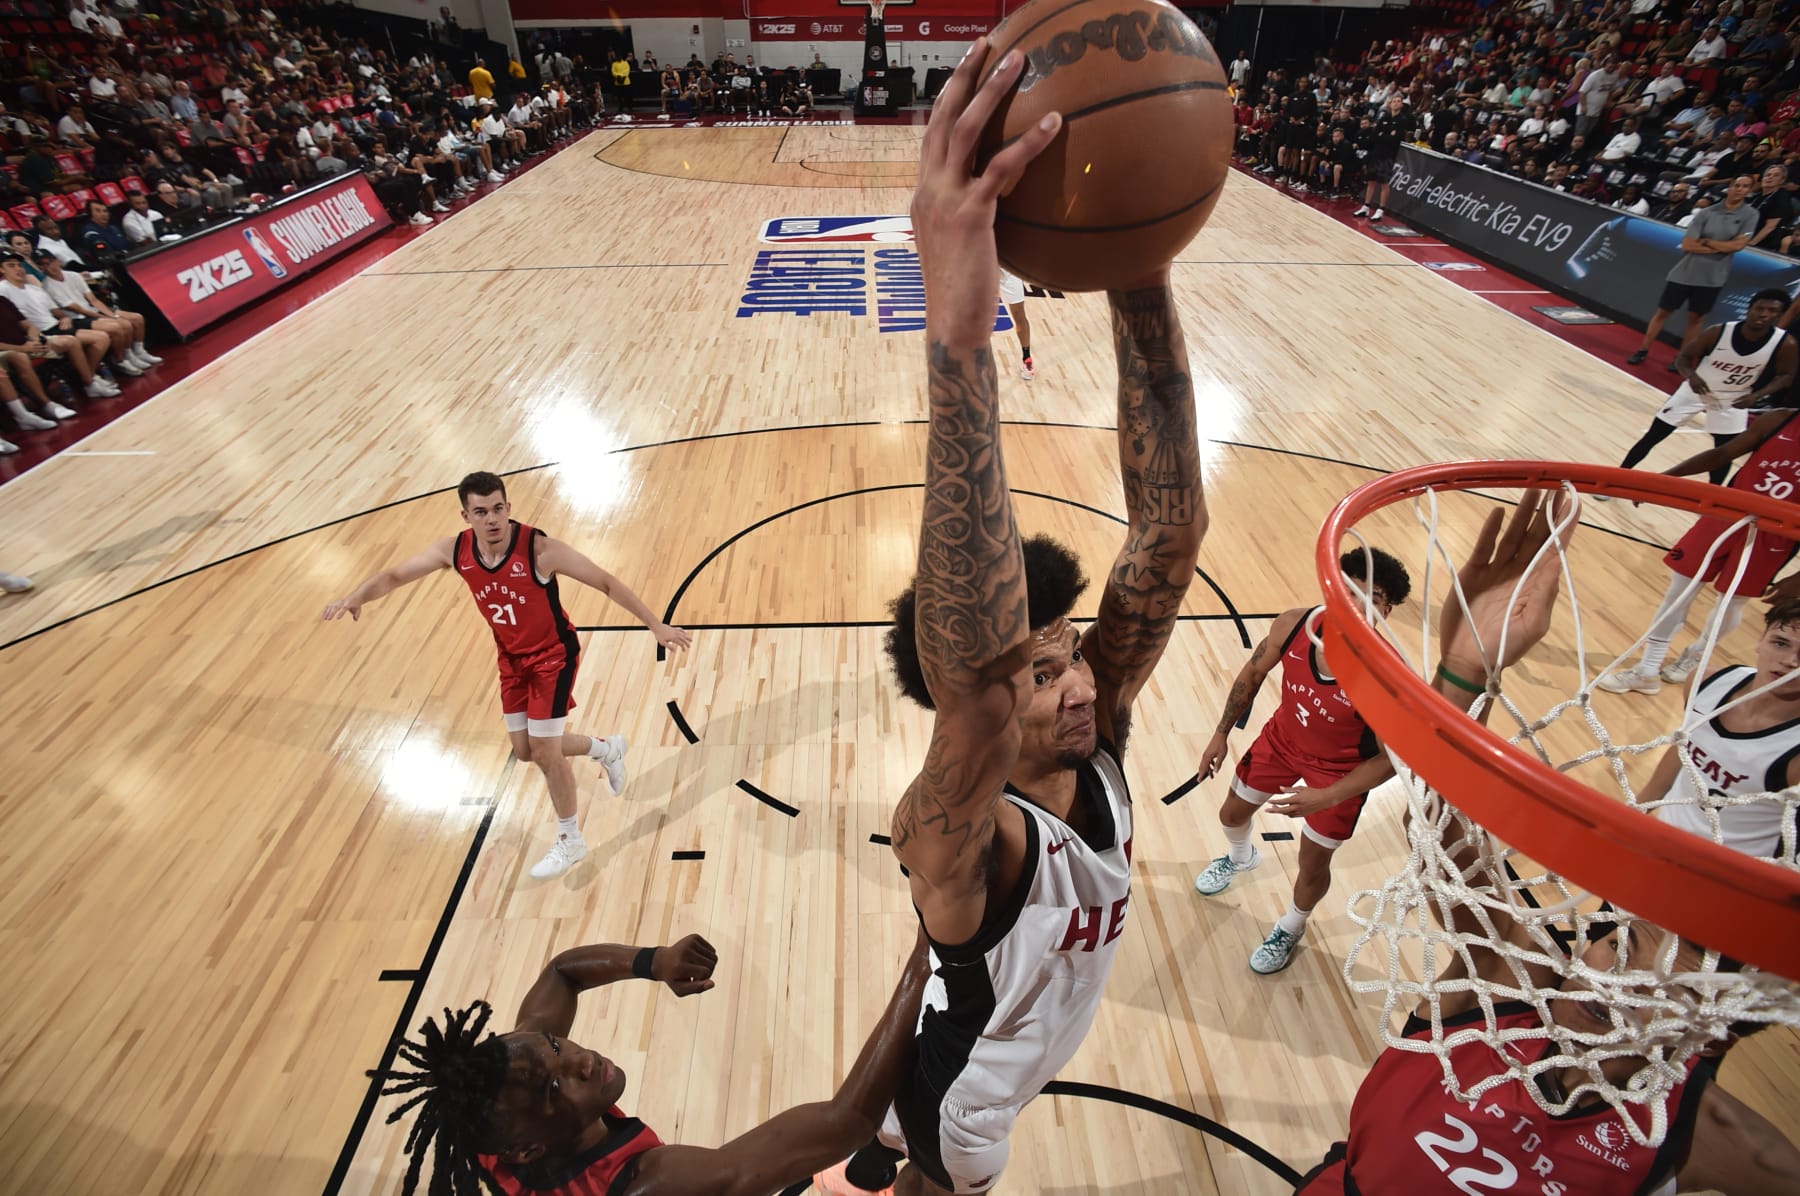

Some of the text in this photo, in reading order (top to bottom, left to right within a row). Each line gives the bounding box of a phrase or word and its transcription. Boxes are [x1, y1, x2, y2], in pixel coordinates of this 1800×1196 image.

[762, 24, 796, 34] 2K25
[822, 24, 844, 33] AT&T
[944, 24, 988, 34] Google Pixel
[794, 119, 855, 127] LEAGUE
[1406, 175, 1490, 222] all-electric
[1484, 201, 1522, 237] Kia
[1517, 214, 1573, 252] EV9
[176, 187, 376, 303] 2K25 SUMMER LEAGUE
[735, 249, 867, 318] LEAGUE
[1711, 360, 1762, 375] HEAT
[1722, 374, 1753, 386] 50
[1753, 471, 1794, 500] 30
[487, 603, 517, 626] 21
[1295, 702, 1310, 728] 3
[1413, 1112, 1519, 1196] 22
[1575, 1134, 1631, 1172] Sun Life
